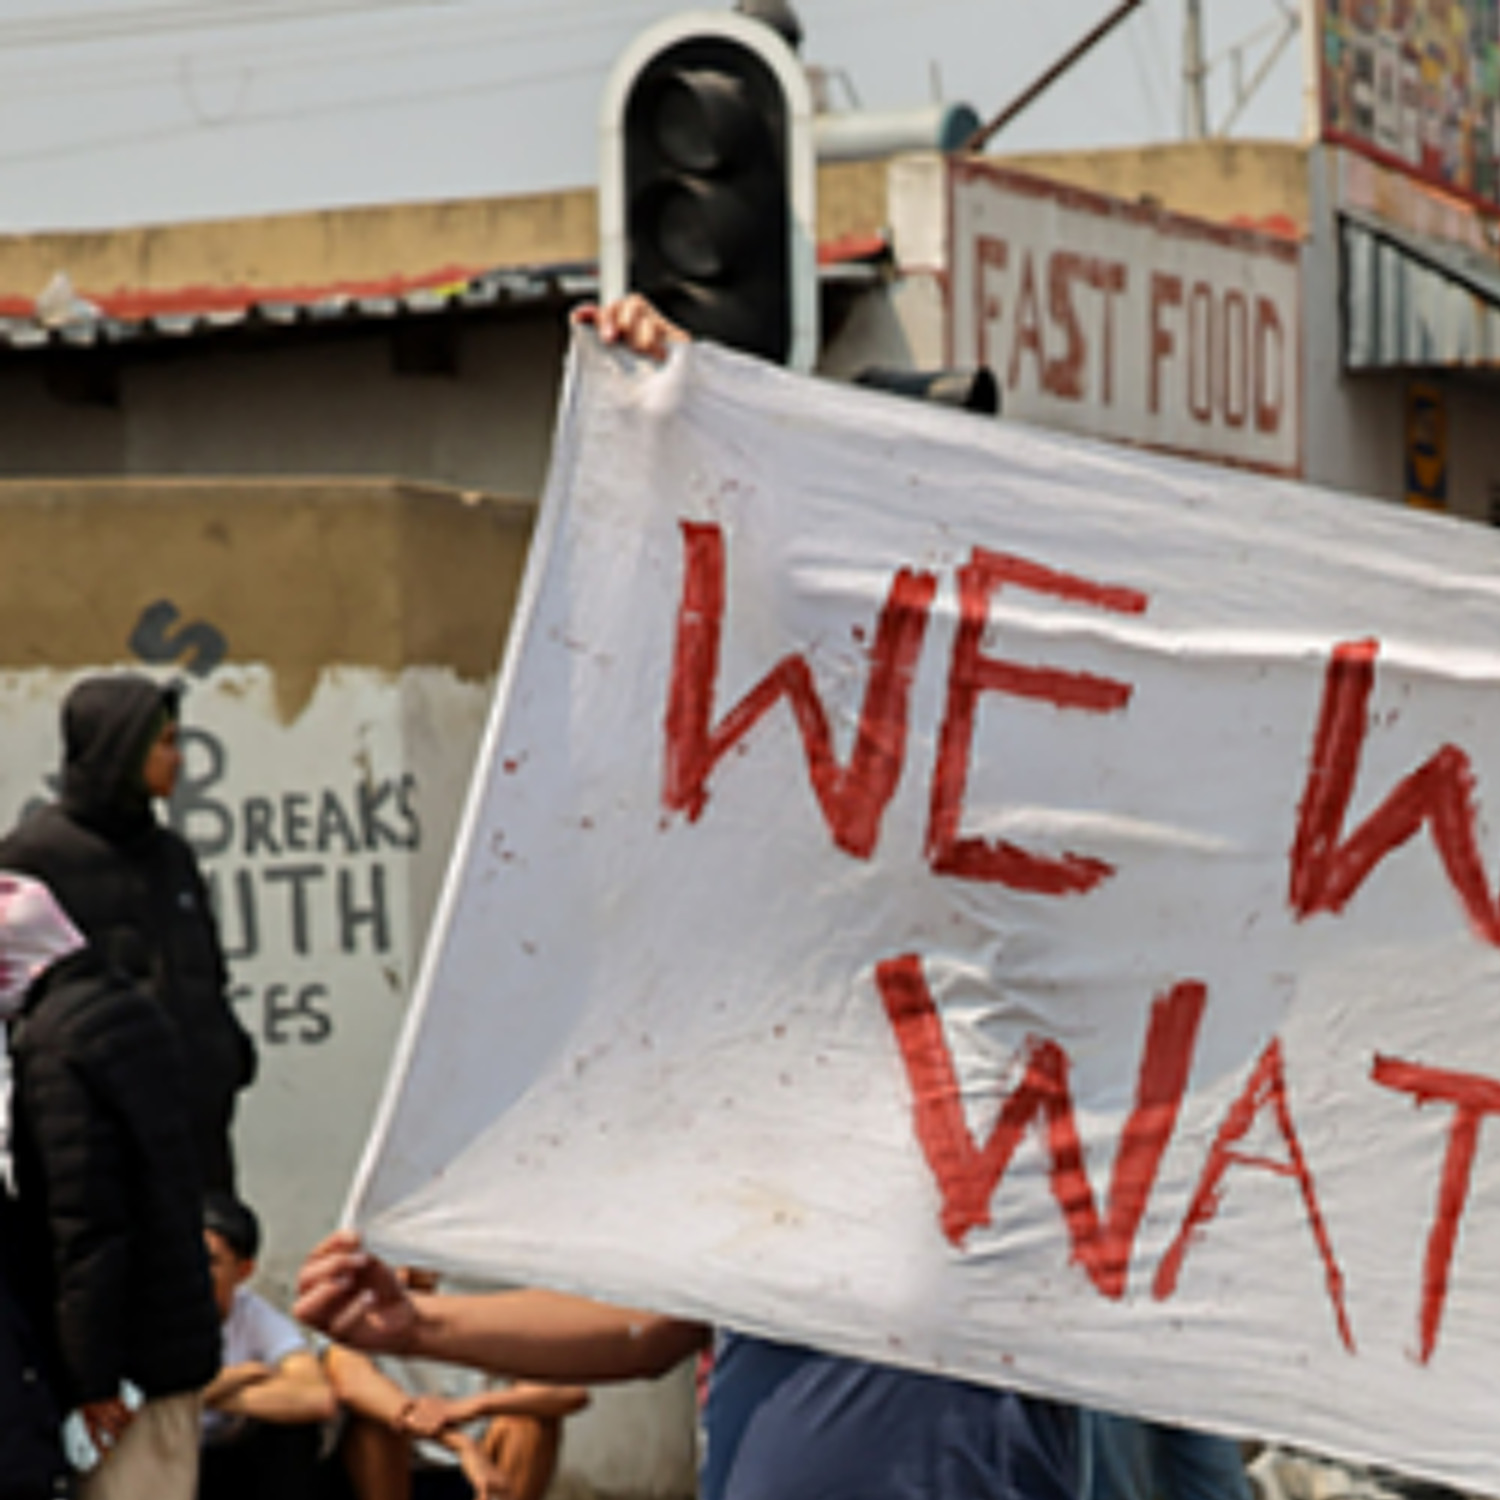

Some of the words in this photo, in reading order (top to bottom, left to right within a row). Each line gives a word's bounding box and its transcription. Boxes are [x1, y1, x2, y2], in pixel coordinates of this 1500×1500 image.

[973, 235, 1127, 406] FAST
[1148, 269, 1285, 434] FOOD
[662, 518, 1149, 896] WE
